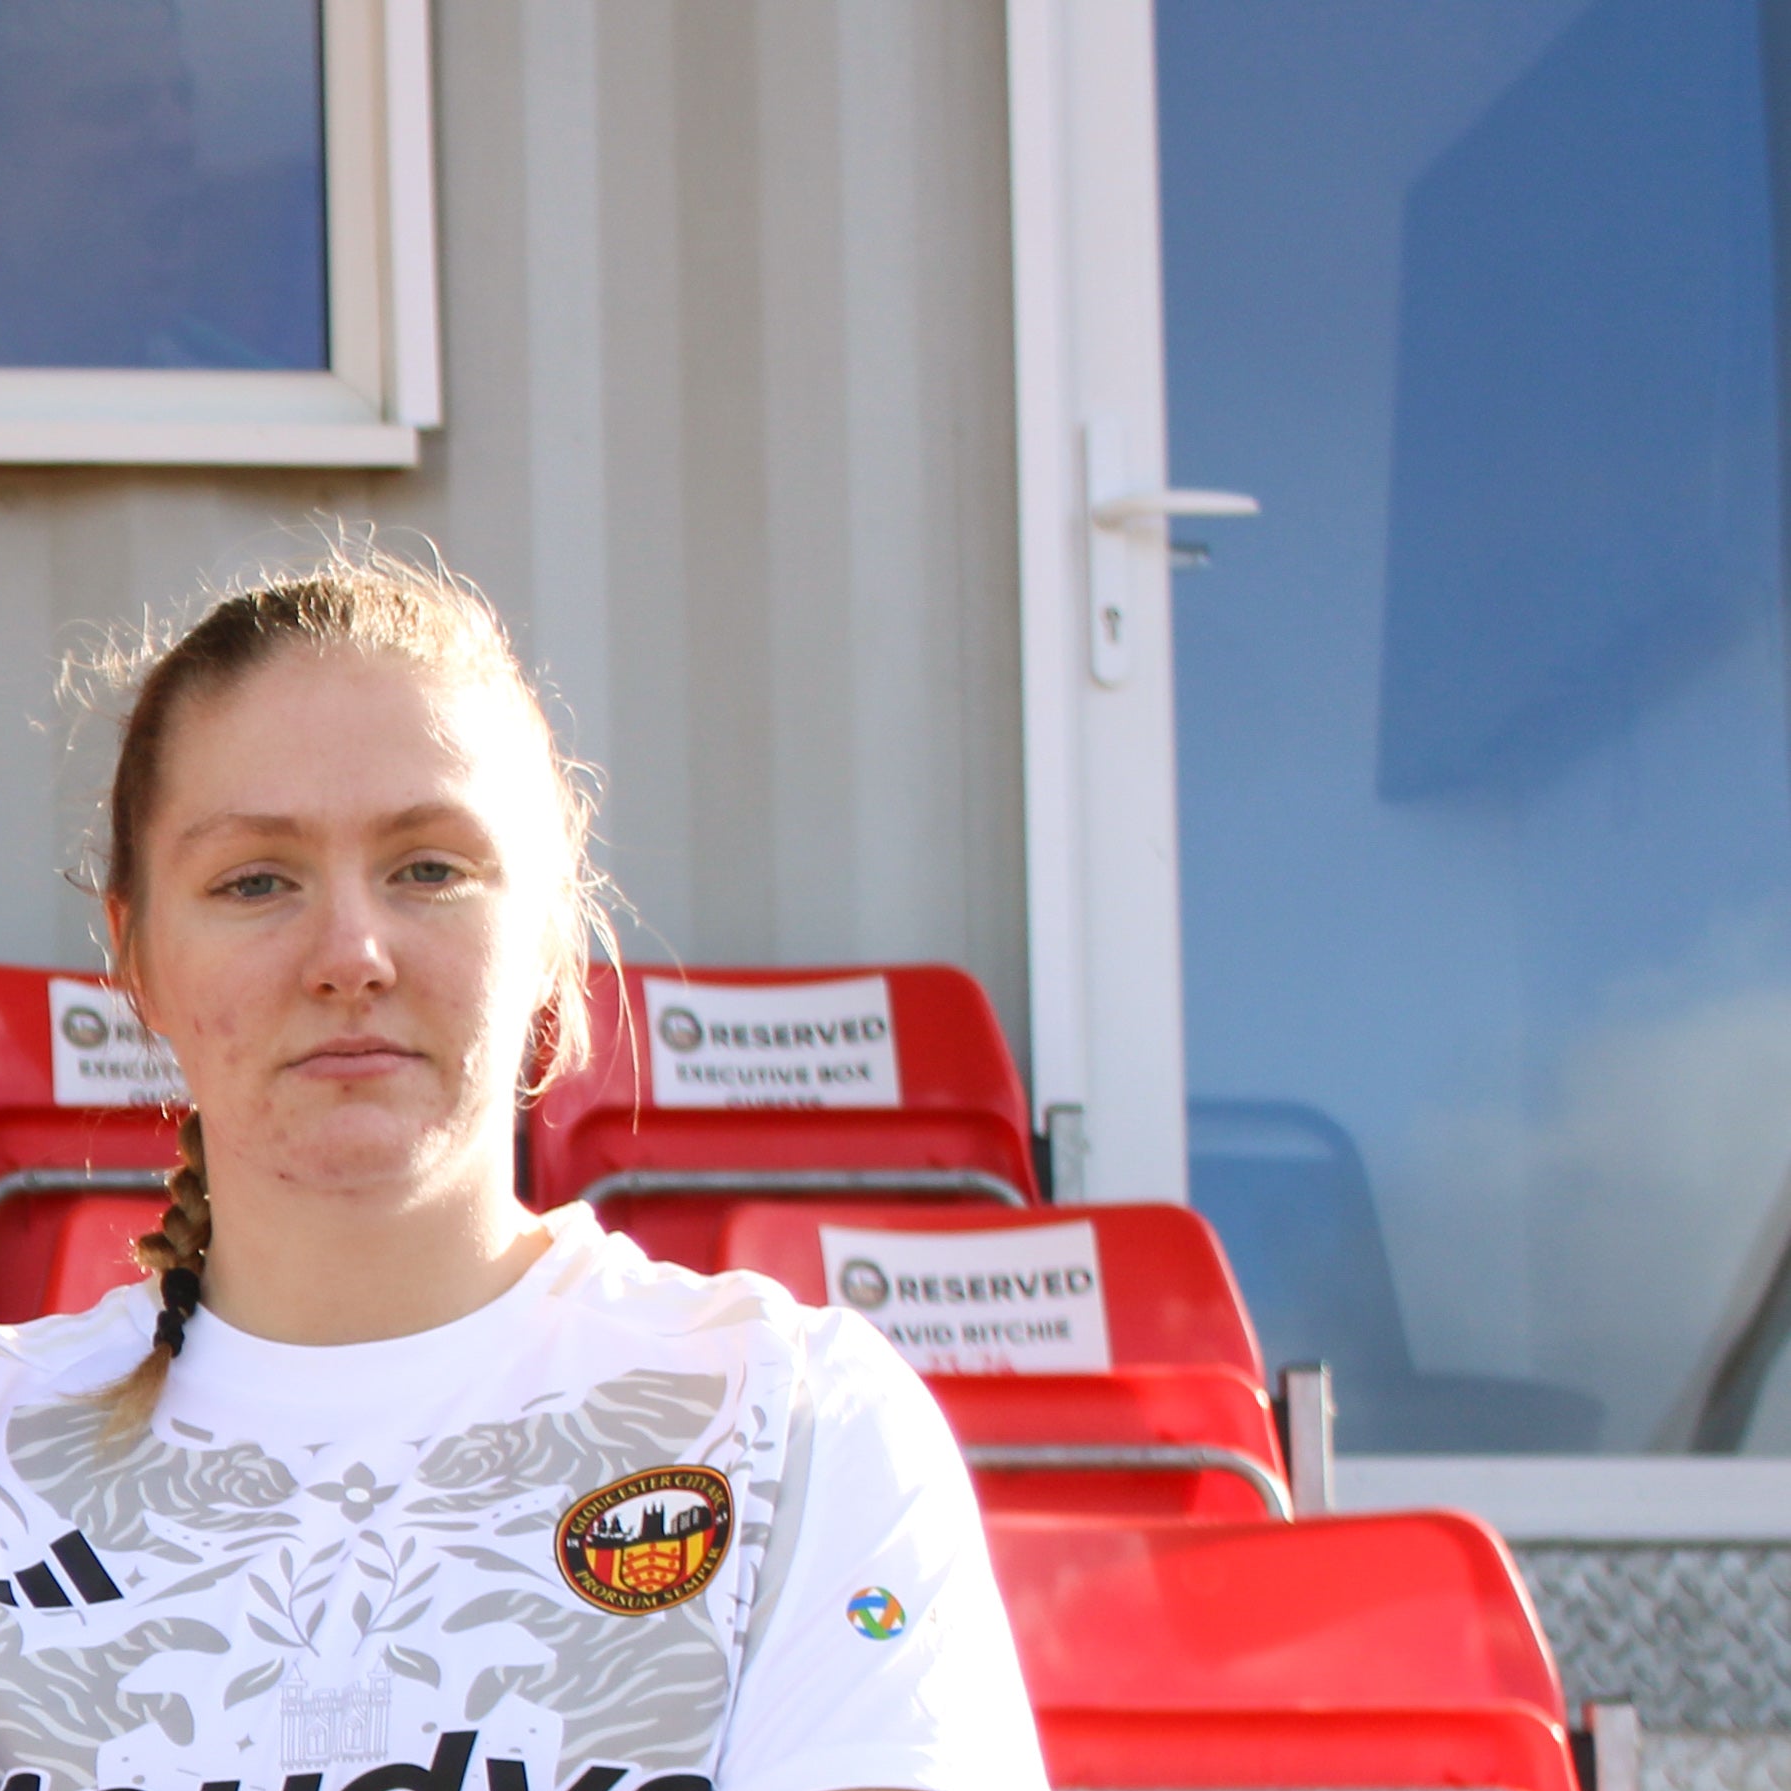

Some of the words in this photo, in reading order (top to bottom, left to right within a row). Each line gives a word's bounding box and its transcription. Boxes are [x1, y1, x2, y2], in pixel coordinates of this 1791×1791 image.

[709, 1016, 886, 1048] RESERVED
[675, 1063, 810, 1085] EXECUTIVE
[817, 1062, 870, 1084] BOX
[896, 1267, 1093, 1303] RESERVED
[889, 1322, 956, 1345] AVID
[960, 1319, 1073, 1345] RITCHIE
[570, 1475, 672, 1535] GLOUCESTER
[575, 1569, 658, 1609] PRORSUM
